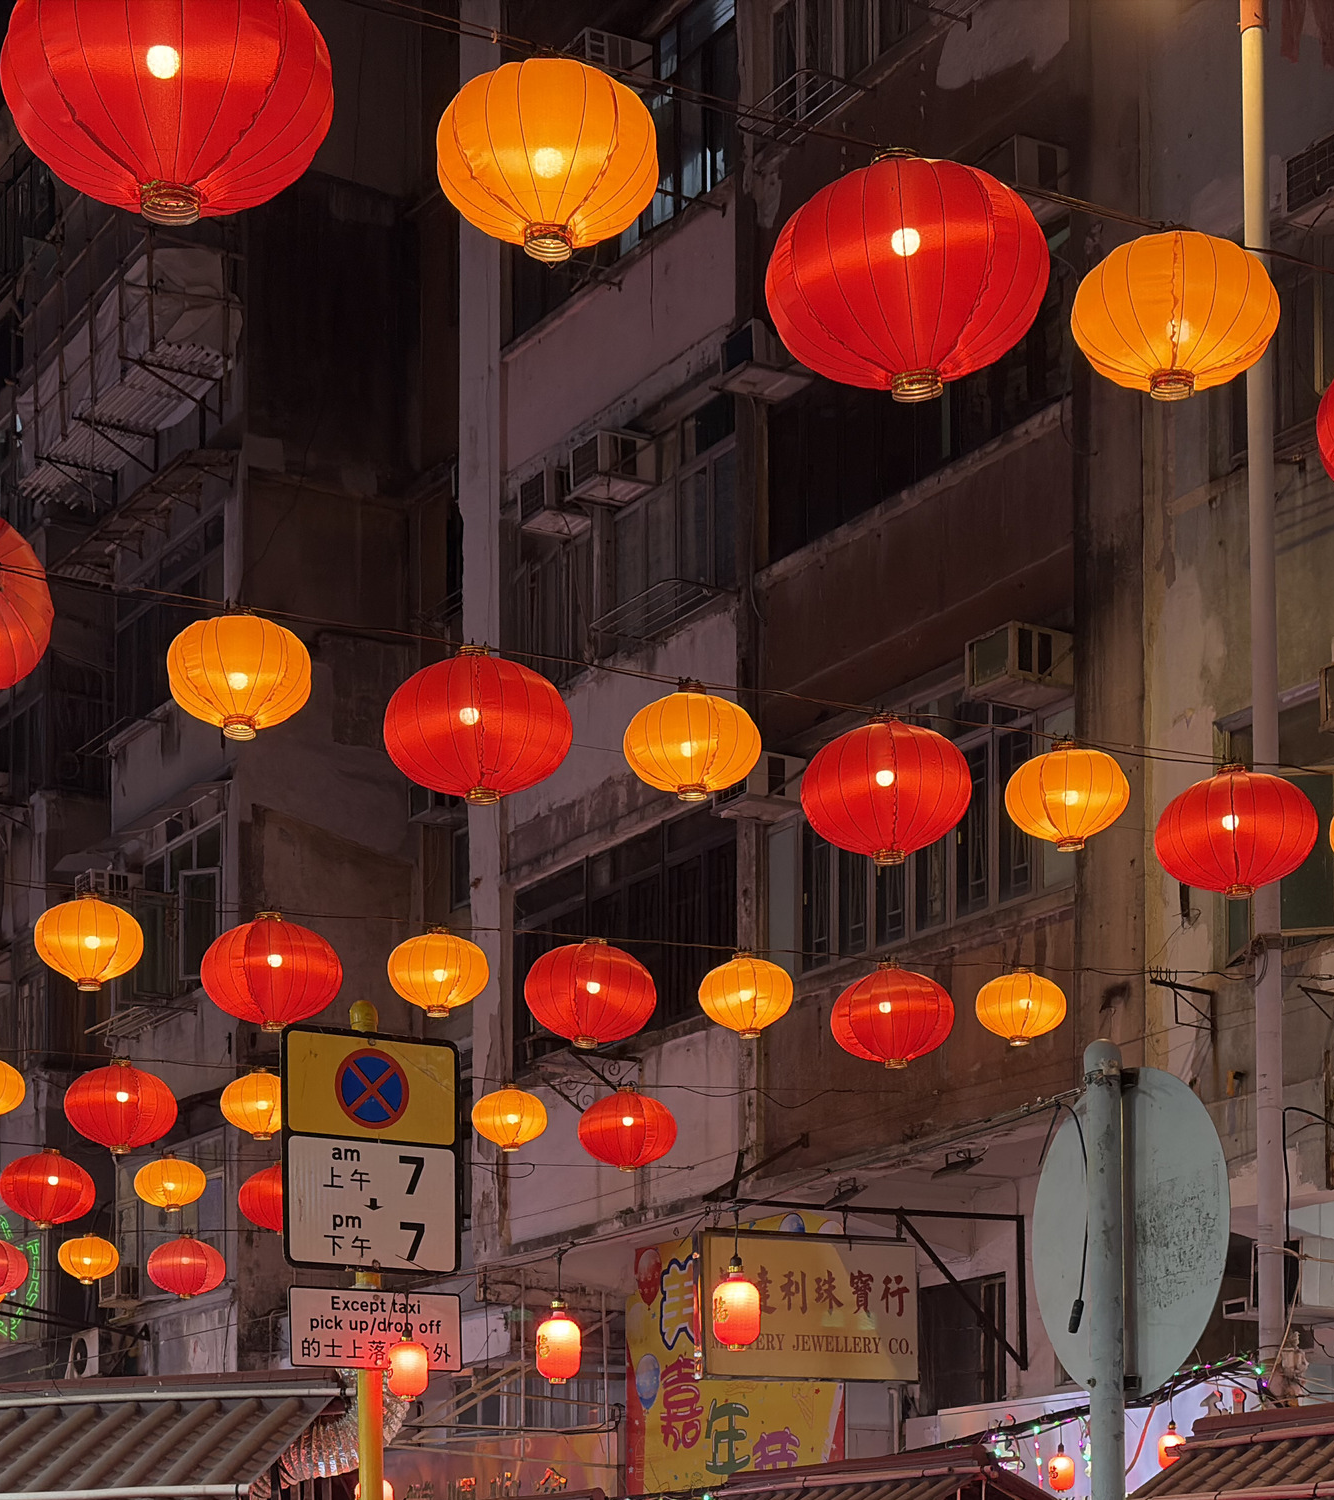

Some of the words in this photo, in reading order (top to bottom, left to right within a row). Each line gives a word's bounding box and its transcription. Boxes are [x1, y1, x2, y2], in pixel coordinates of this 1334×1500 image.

[322, 1166, 371, 1192] 上午
[331, 1147, 361, 1162] am
[398, 1155, 425, 1196] 7
[323, 1234, 372, 1259] 下午
[332, 1213, 362, 1231] pm
[399, 1221, 426, 1262] 7
[718, 1264, 911, 1318] 達利珠寶行
[330, 1296, 387, 1315] Except
[391, 1298, 421, 1314] taxi
[309, 1315, 343, 1331] pick
[348, 1317, 414, 1336] up/drop
[418, 1320, 442, 1334] off
[301, 1337, 452, 1364] 的士上落外
[791, 1334, 882, 1355] JEWELLERY
[887, 1336, 914, 1356] CO.
